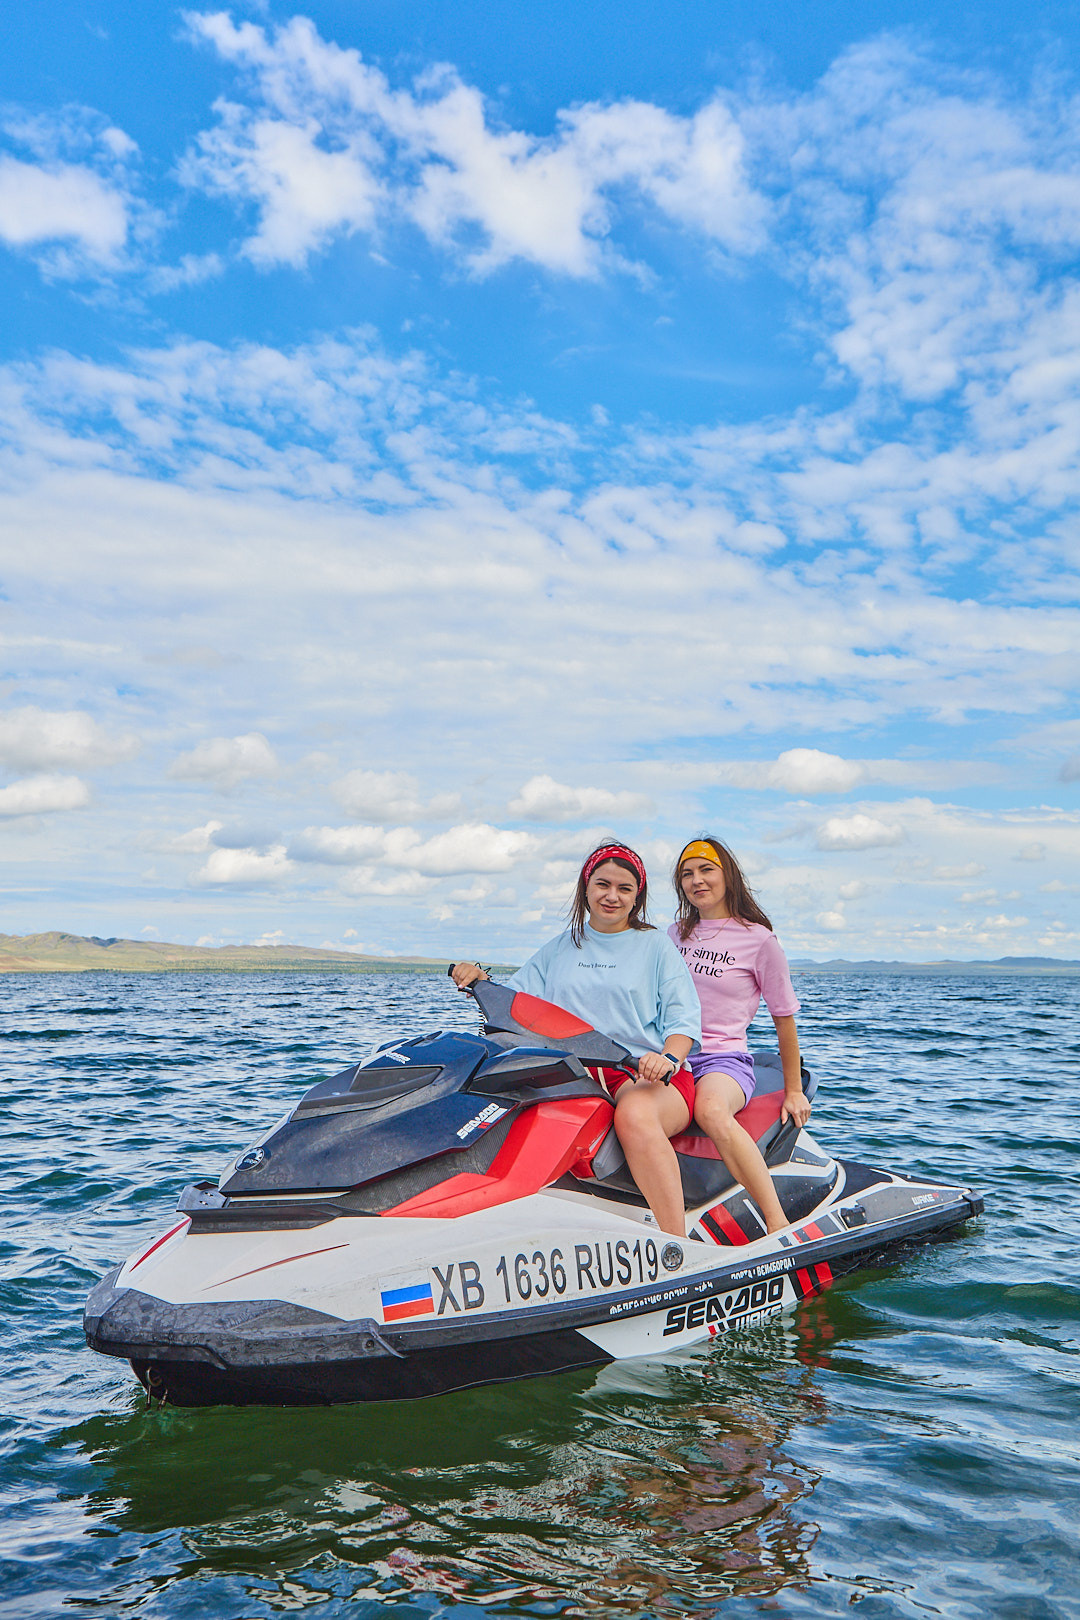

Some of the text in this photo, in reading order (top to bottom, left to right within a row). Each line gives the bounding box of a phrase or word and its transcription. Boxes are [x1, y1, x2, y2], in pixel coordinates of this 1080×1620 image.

[692, 947, 736, 965] simple
[694, 962, 723, 977] true
[496, 1248, 567, 1303] 1636
